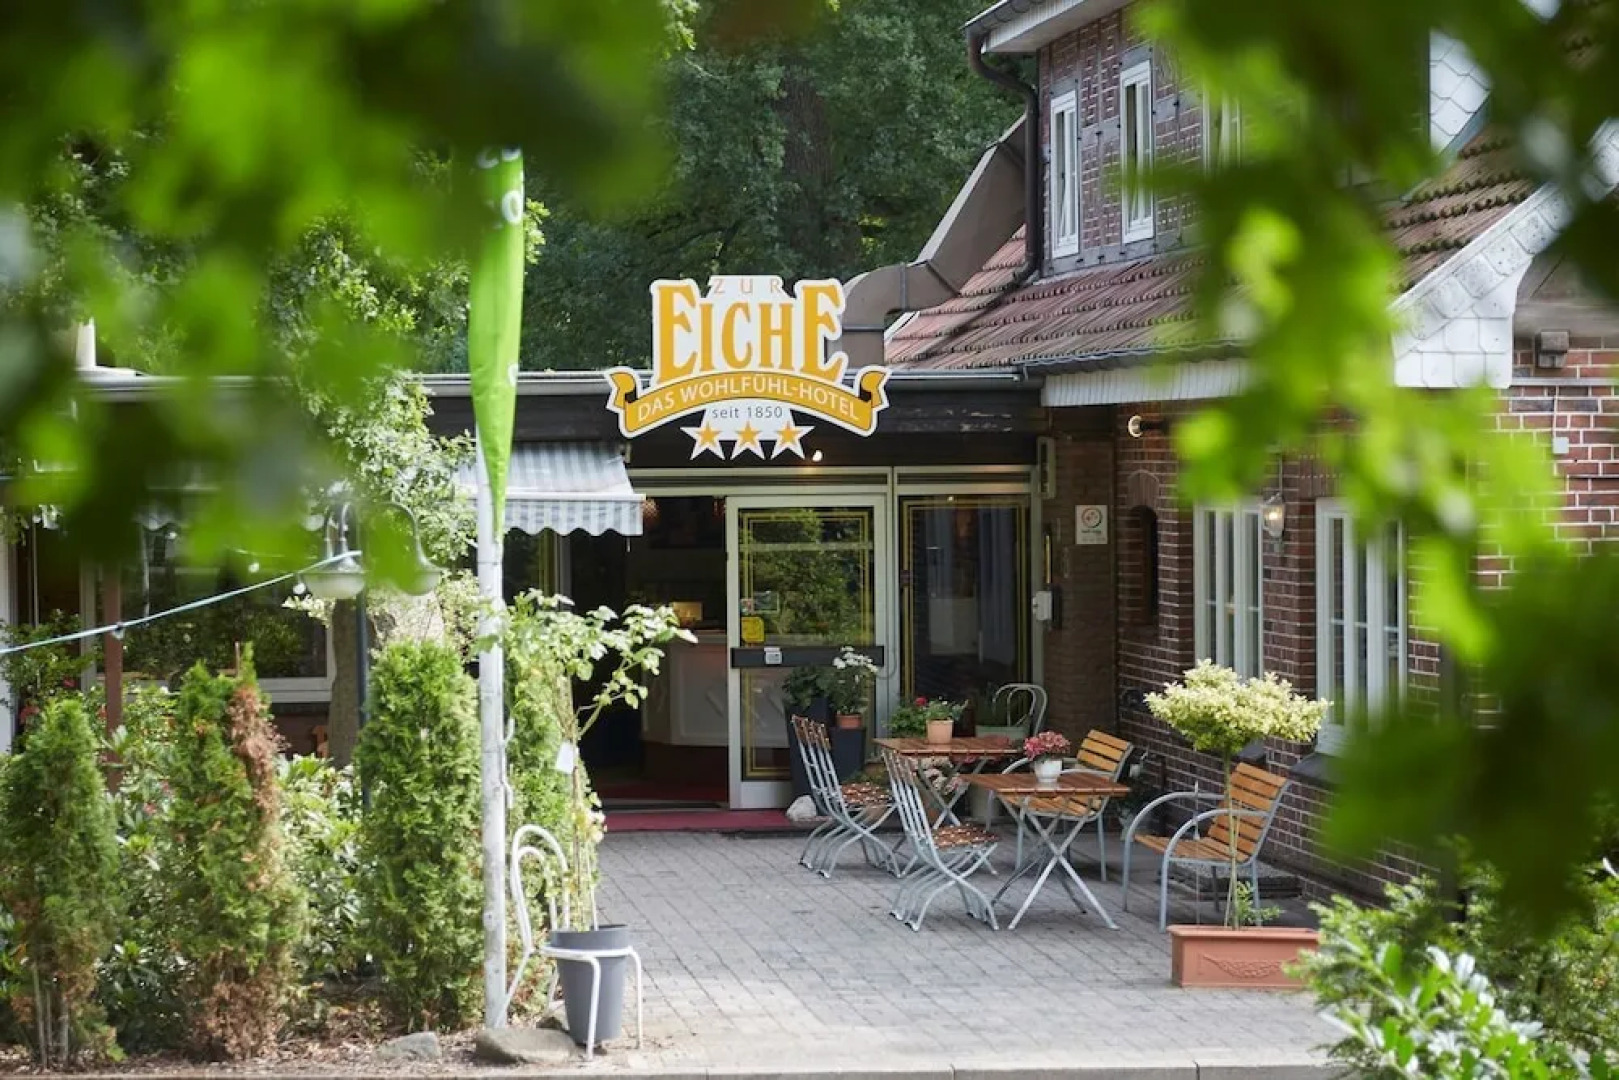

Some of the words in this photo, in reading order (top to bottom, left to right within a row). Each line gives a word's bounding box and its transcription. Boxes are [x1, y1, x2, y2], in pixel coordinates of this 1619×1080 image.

[713, 278, 781, 294] ZUR
[658, 284, 844, 383] EICHE
[637, 391, 675, 422] DAS
[680, 374, 859, 421] WOHLFÜHL-HOTEL
[711, 407, 739, 419] seit
[747, 406, 783, 418] 1850
